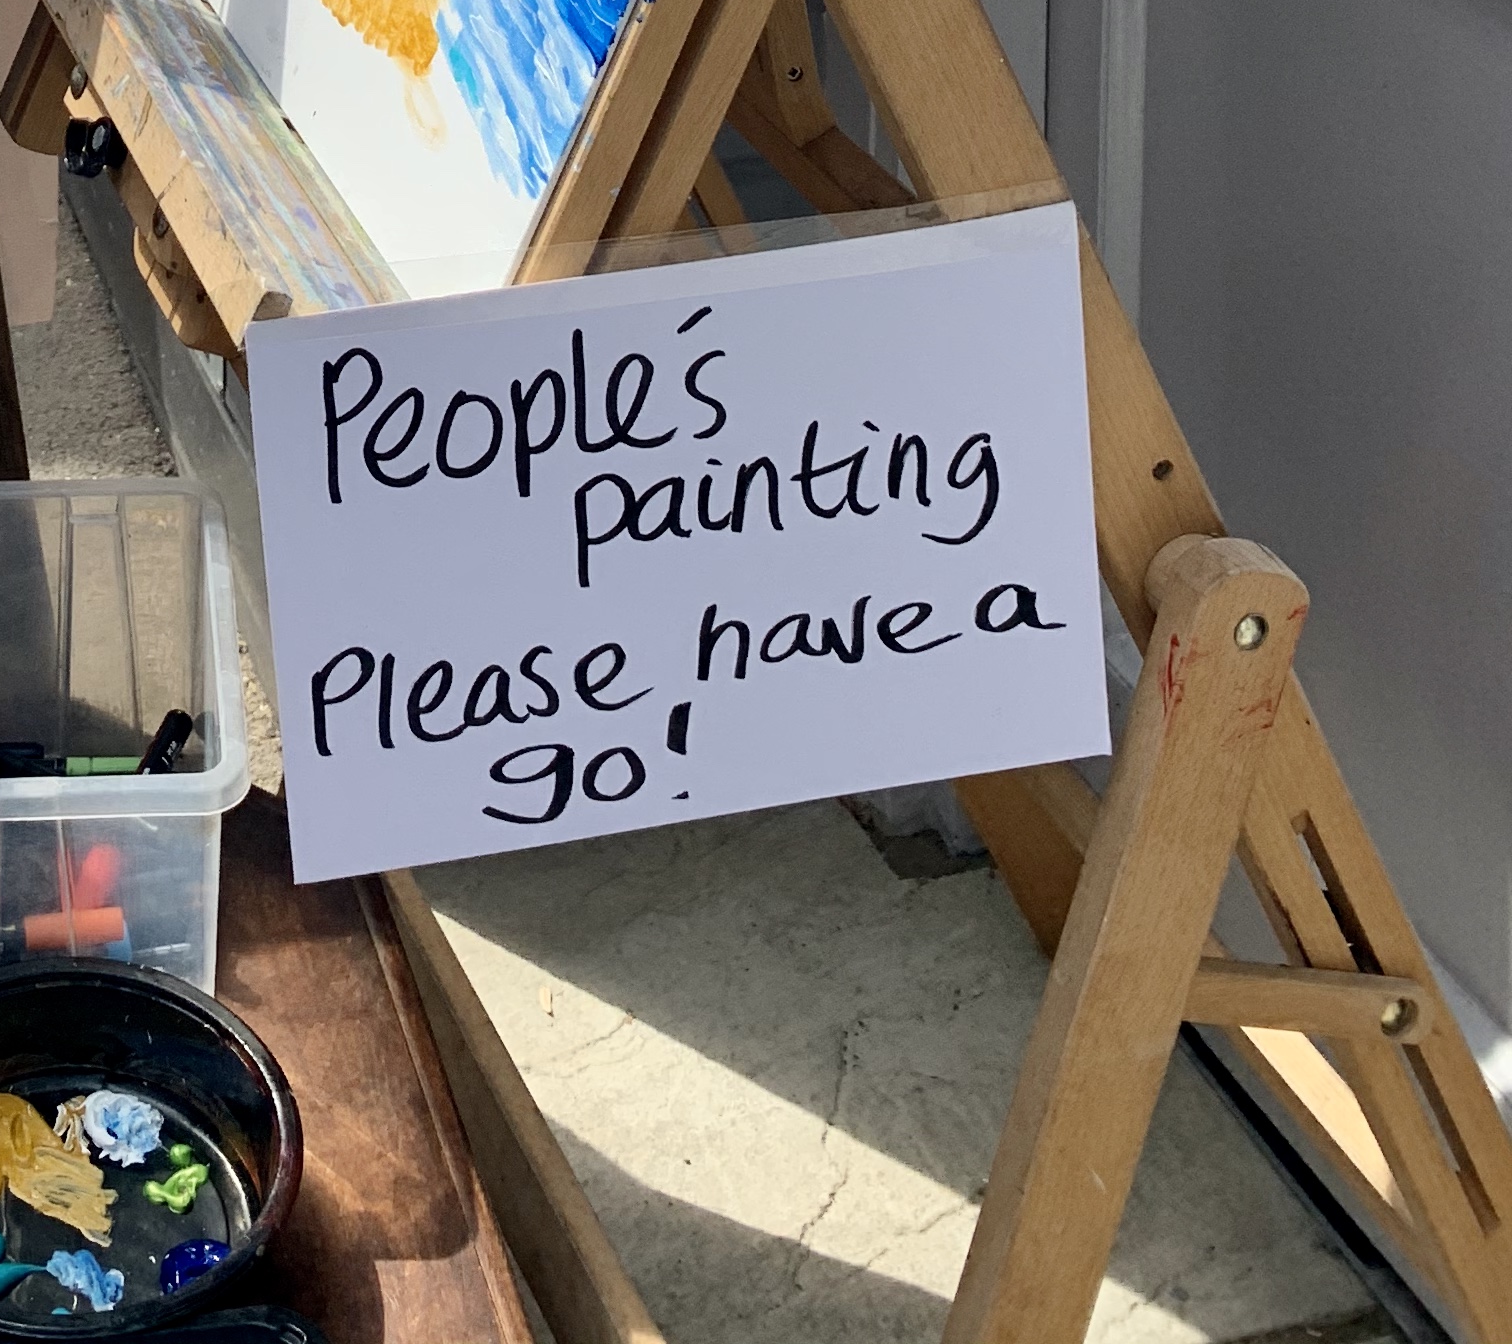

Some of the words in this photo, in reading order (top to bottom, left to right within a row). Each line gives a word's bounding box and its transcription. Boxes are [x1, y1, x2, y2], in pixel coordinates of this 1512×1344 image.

[321, 305, 728, 504] People's
[576, 419, 1002, 589] painting
[311, 643, 655, 758] Please
[696, 593, 963, 683] have
[974, 581, 1068, 633] a
[481, 700, 693, 826] go!
